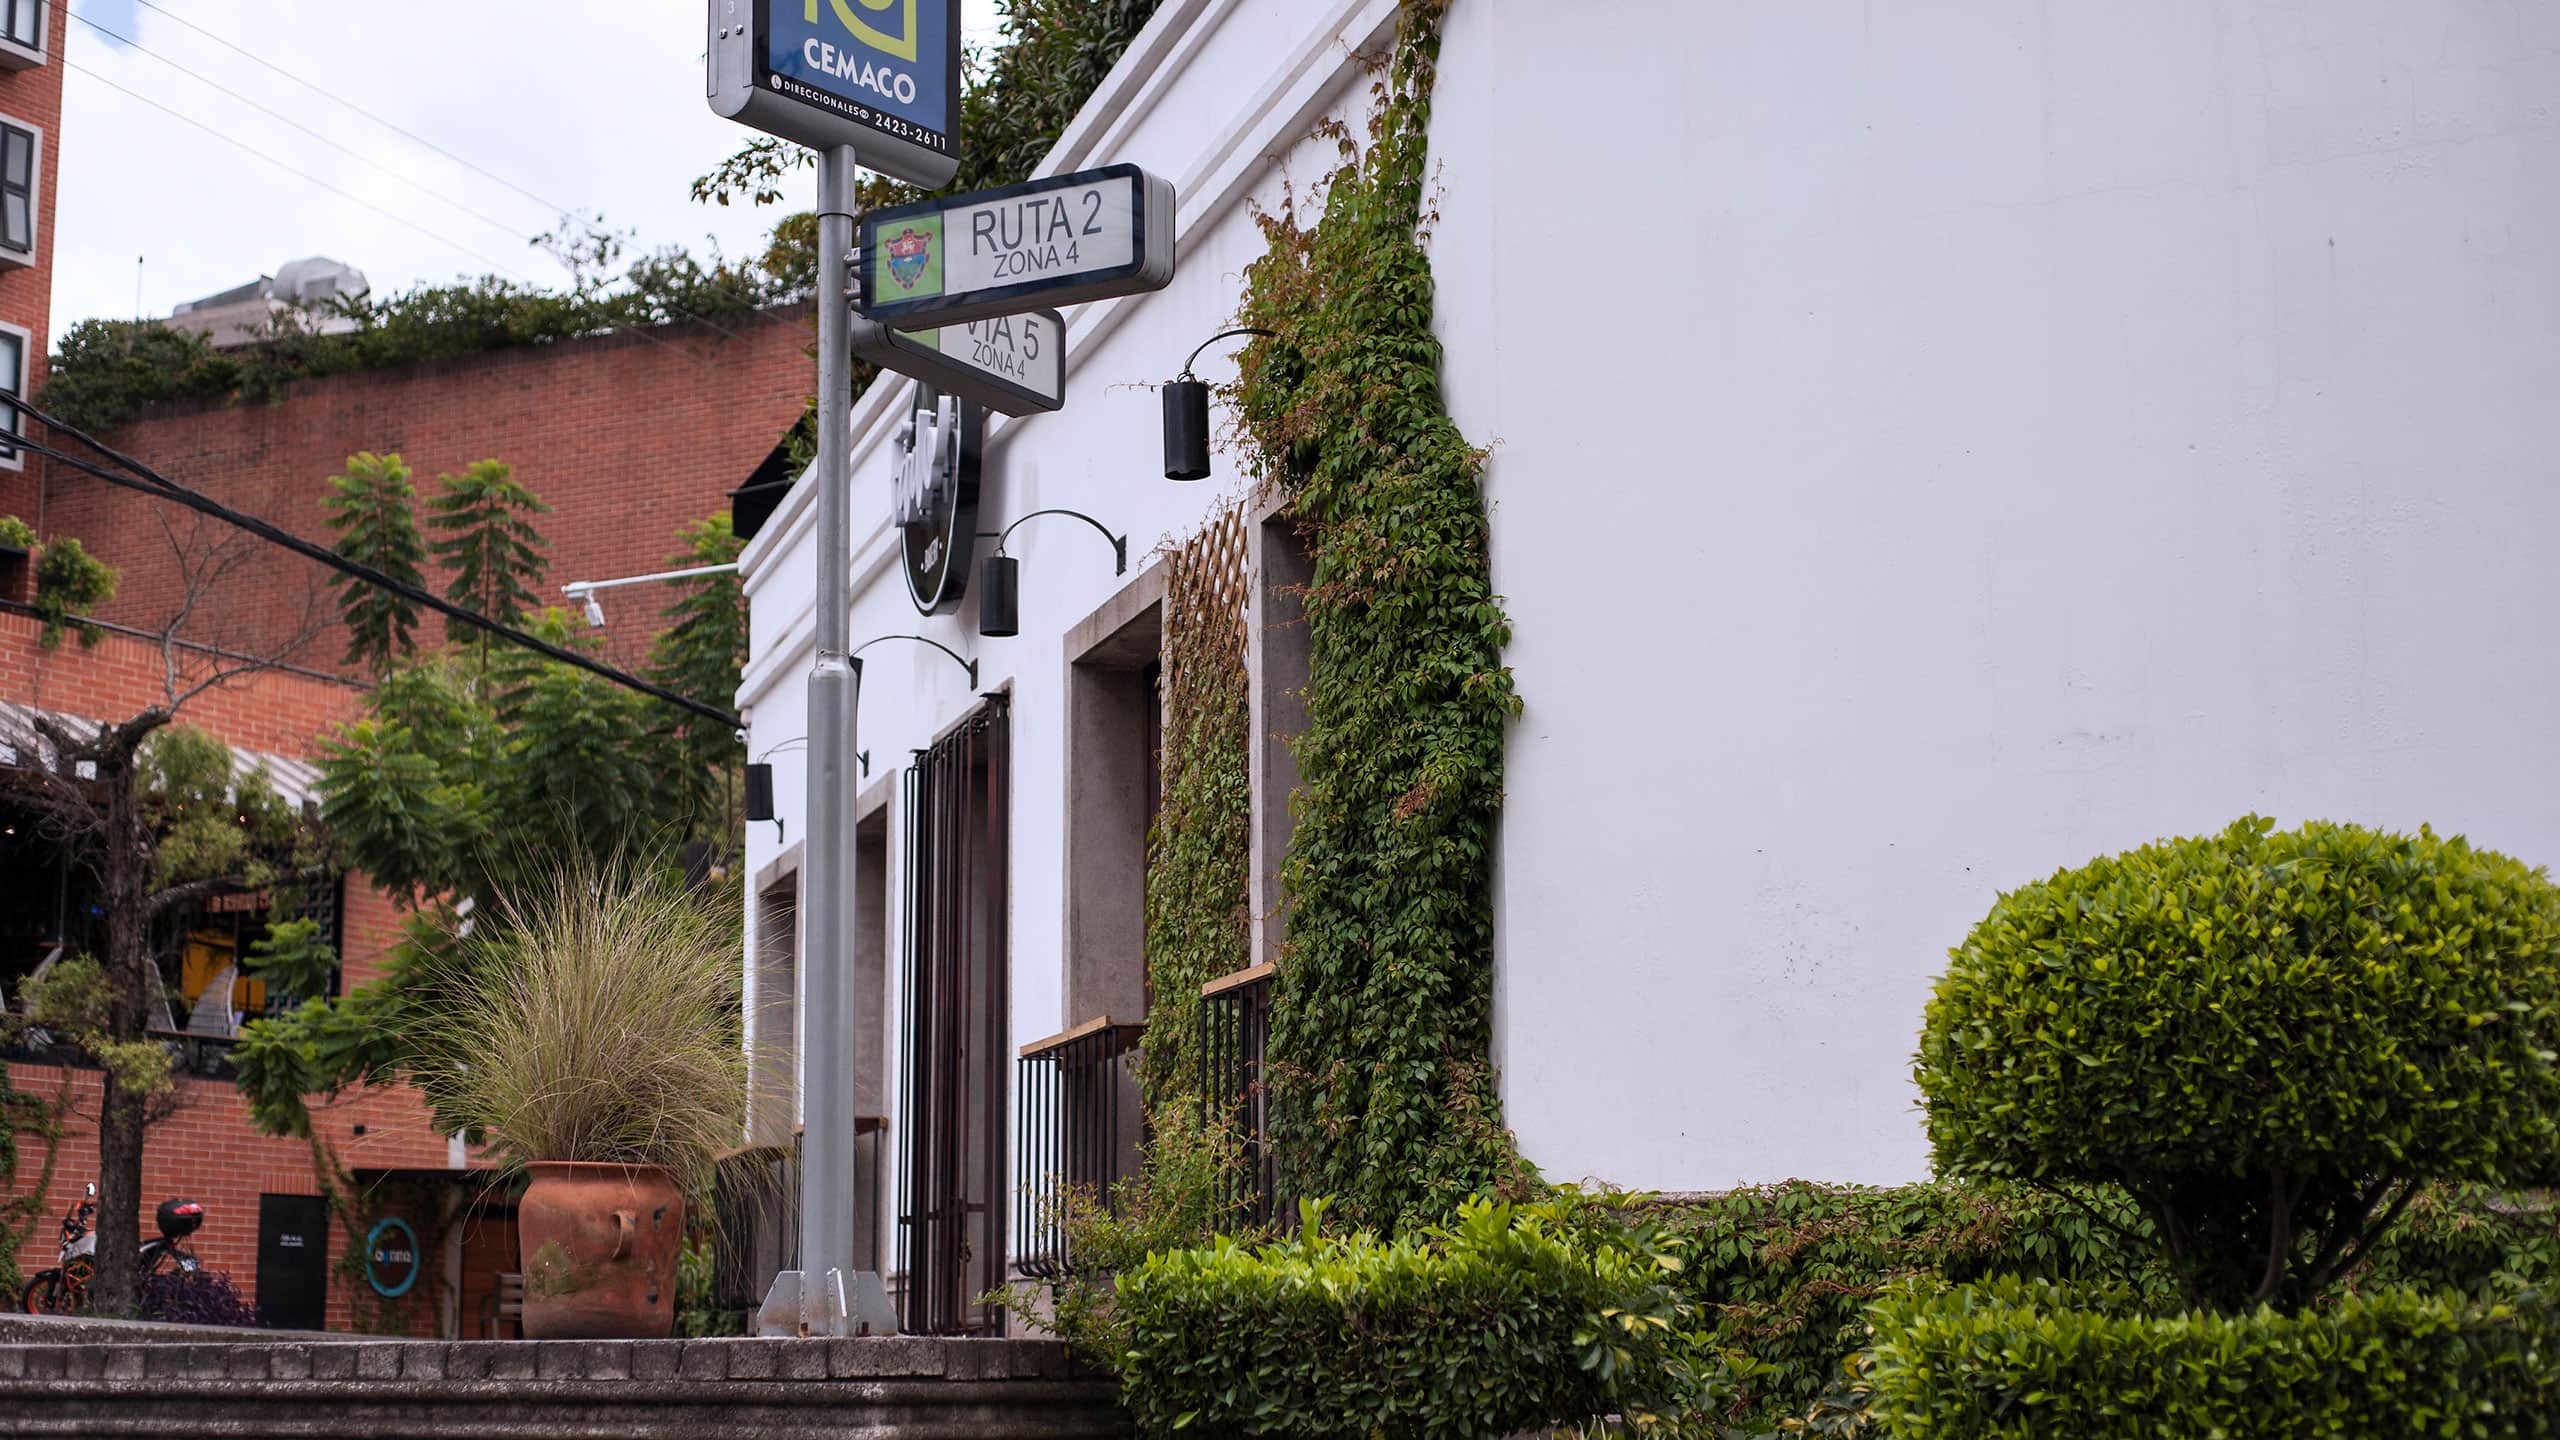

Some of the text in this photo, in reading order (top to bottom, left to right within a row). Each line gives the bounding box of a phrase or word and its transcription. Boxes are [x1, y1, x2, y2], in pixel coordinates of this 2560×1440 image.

[804, 38, 916, 104] CEMACO
[875, 113, 947, 150] 2423-2611
[973, 190, 1102, 256] RUTA 2
[994, 241, 1080, 278] ZONA 4
[973, 339, 1025, 380] ZONA 4
[1024, 319, 1039, 360] 5
